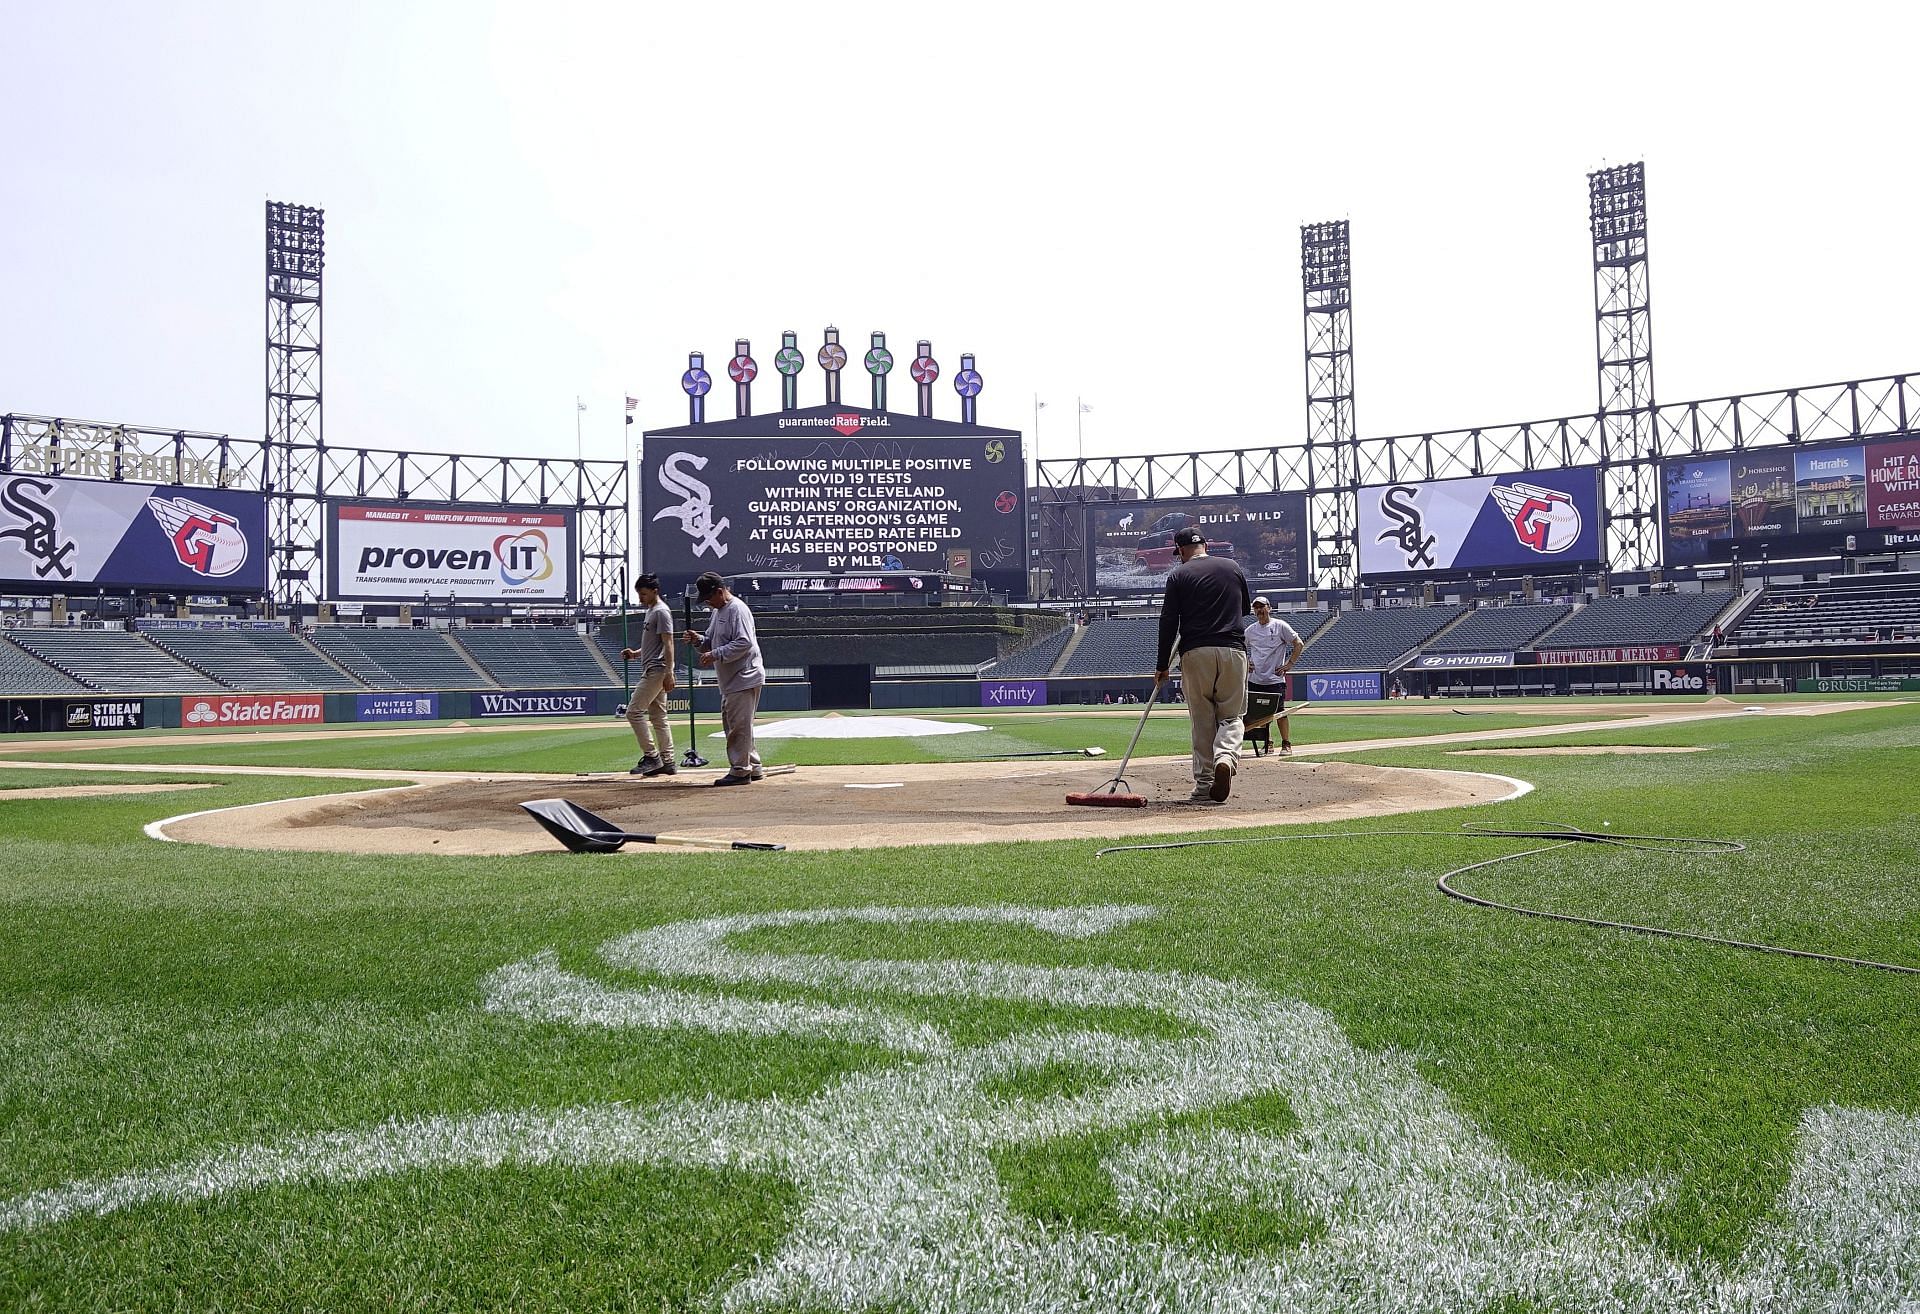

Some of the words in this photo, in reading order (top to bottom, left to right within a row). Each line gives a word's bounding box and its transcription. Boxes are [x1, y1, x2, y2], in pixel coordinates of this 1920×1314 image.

[778, 417, 836, 429] guaranteed
[837, 417, 859, 427] Rate
[24, 420, 140, 447] CAESARS
[24, 444, 215, 486] SPORTSBOOK
[737, 459, 828, 471] FOLLOWING
[832, 459, 901, 471] MULTIPLE
[905, 458, 972, 470] POSITIVE
[1883, 456, 1905, 467] HIT
[1909, 454, 1919, 465] A
[798, 473, 845, 485] COVID
[849, 473, 864, 485] 19
[869, 473, 912, 485] TESTS
[1871, 466, 1905, 483] HOME
[1908, 464, 1920, 480] RU
[765, 486, 821, 498] WITHIN
[824, 486, 854, 498] THE
[857, 486, 945, 498] CLEVELAND
[1884, 480, 1919, 492] WITH
[748, 500, 841, 512] GUARDIANS'
[844, 500, 962, 514] ORGANIZATION,
[1878, 502, 1920, 513] CAESAR
[365, 511, 400, 519] MANAGED
[401, 512, 409, 520] IT
[424, 513, 464, 522] WORKFLOW
[464, 515, 507, 524] AUTOMATION
[758, 514, 792, 526] THIS
[796, 513, 902, 526] AFTERNOON'S
[906, 513, 948, 525] GAME
[1199, 513, 1240, 523] BUILT
[1880, 510, 1920, 521] REWARD
[1748, 524, 1782, 532] HAMMOND
[1822, 518, 1843, 526] JOLIET
[749, 528, 769, 540] AT
[772, 528, 875, 540] GUARANTEED
[878, 527, 915, 539] RATE
[921, 527, 962, 539] FIELD
[1906, 534, 1920, 543] LA
[770, 542, 801, 555] HAS
[805, 542, 844, 554] BEEN
[848, 541, 938, 554] POSTPONED
[358, 546, 492, 574] proven
[510, 546, 538, 571] IT
[828, 556, 847, 568] BY
[851, 555, 885, 568] MLB.
[355, 576, 407, 584] TRANSFORMING
[408, 577, 448, 585] WORKPLACE
[449, 578, 496, 586] PRODUCTIVITY
[782, 579, 808, 590] WHITE
[809, 579, 826, 590] SOX
[838, 578, 883, 590] GUARDIANS
[1446, 655, 1507, 665] HYUNDAI
[1540, 649, 1617, 664] WHITTINGHAM
[1622, 647, 1659, 662] MEATS
[1330, 679, 1378, 689] FANDUEL
[1653, 669, 1703, 689] Rate
[1830, 681, 1868, 691] RUSH
[990, 685, 1036, 704] xfinity
[93, 703, 141, 715] STREAM
[373, 700, 413, 708] UNITED
[480, 694, 587, 713] WINTRUST
[363, 707, 413, 715] AIRLINES
[93, 715, 124, 727] YOUR
